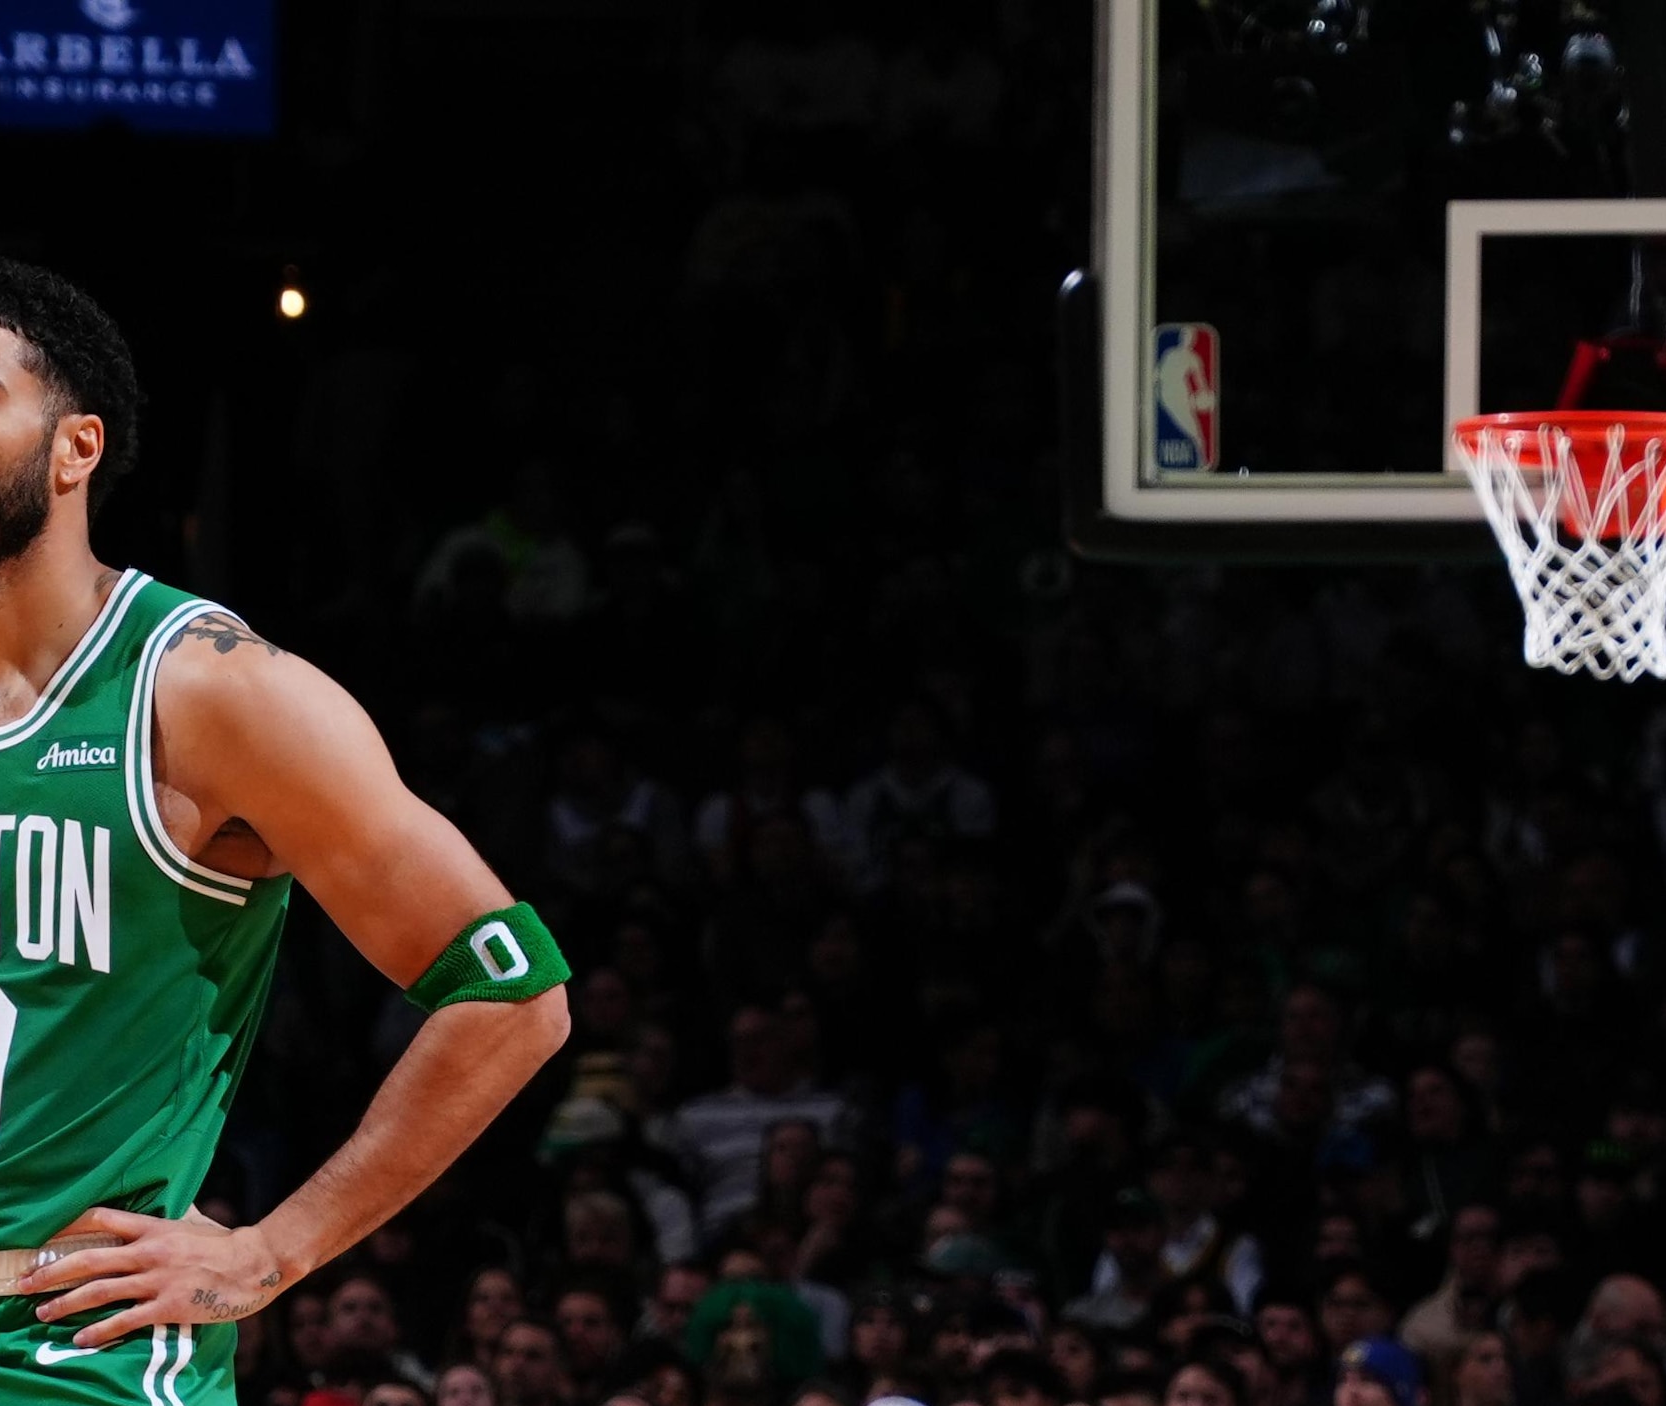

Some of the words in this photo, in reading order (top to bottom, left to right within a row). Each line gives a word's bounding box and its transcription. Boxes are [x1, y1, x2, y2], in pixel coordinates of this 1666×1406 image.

[37, 741, 116, 770] Amica
[469, 920, 529, 982] 0
[190, 1287, 219, 1310] Big
